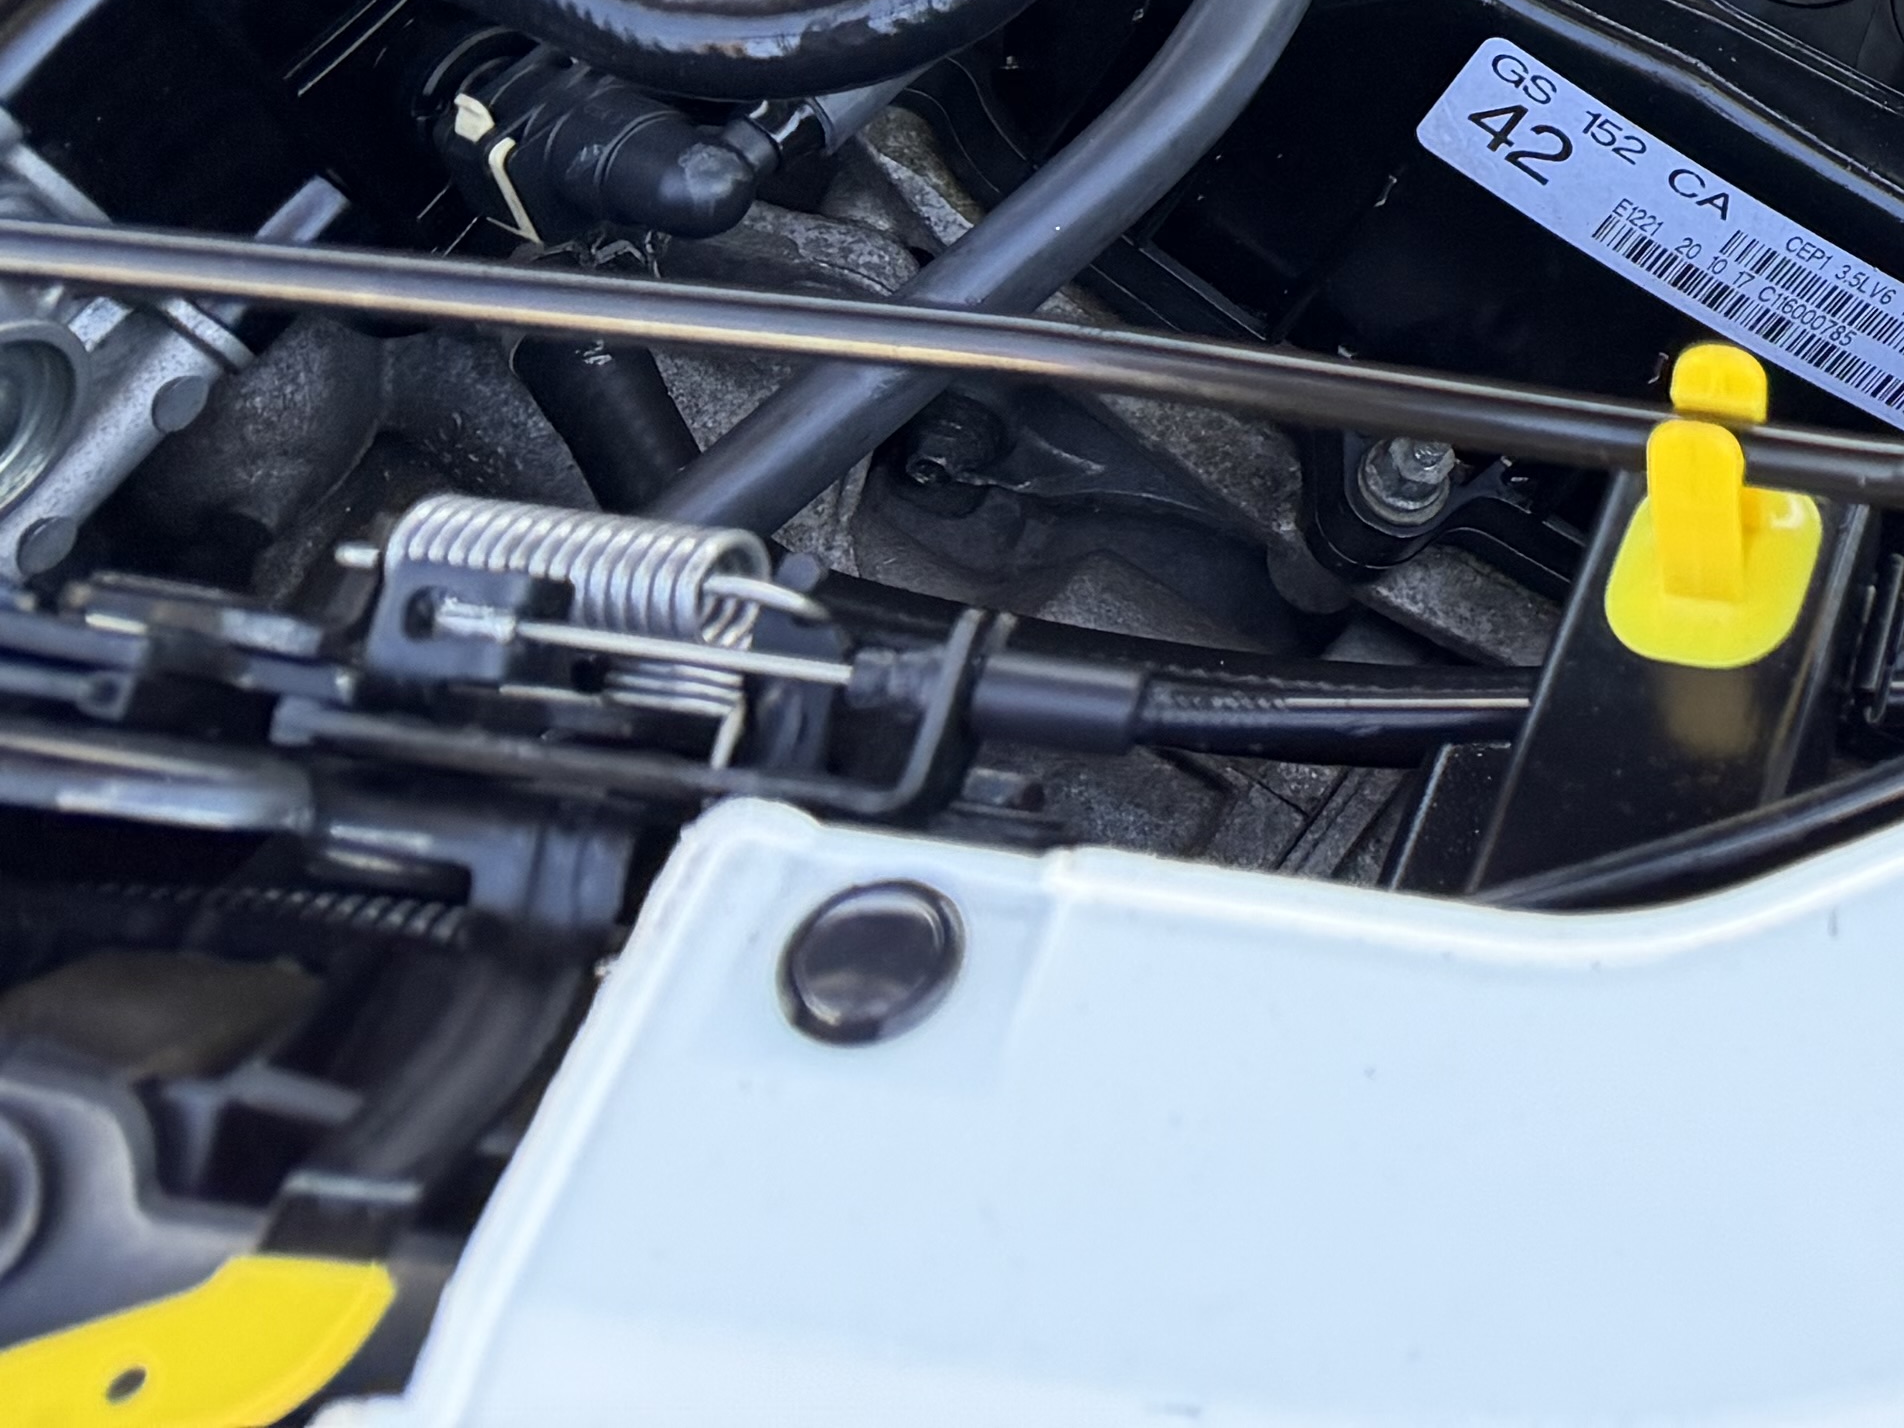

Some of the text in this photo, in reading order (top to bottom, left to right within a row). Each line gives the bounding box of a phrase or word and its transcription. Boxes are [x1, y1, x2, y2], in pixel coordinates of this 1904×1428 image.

[1467, 104, 1575, 186] 42
[1491, 53, 1735, 221] GS 152 CA
[1613, 197, 1665, 237] E1221
[1675, 236, 1703, 261] 20
[1706, 253, 1729, 276] 10
[1731, 269, 1755, 290] 17
[1784, 235, 1832, 271] CEP1
